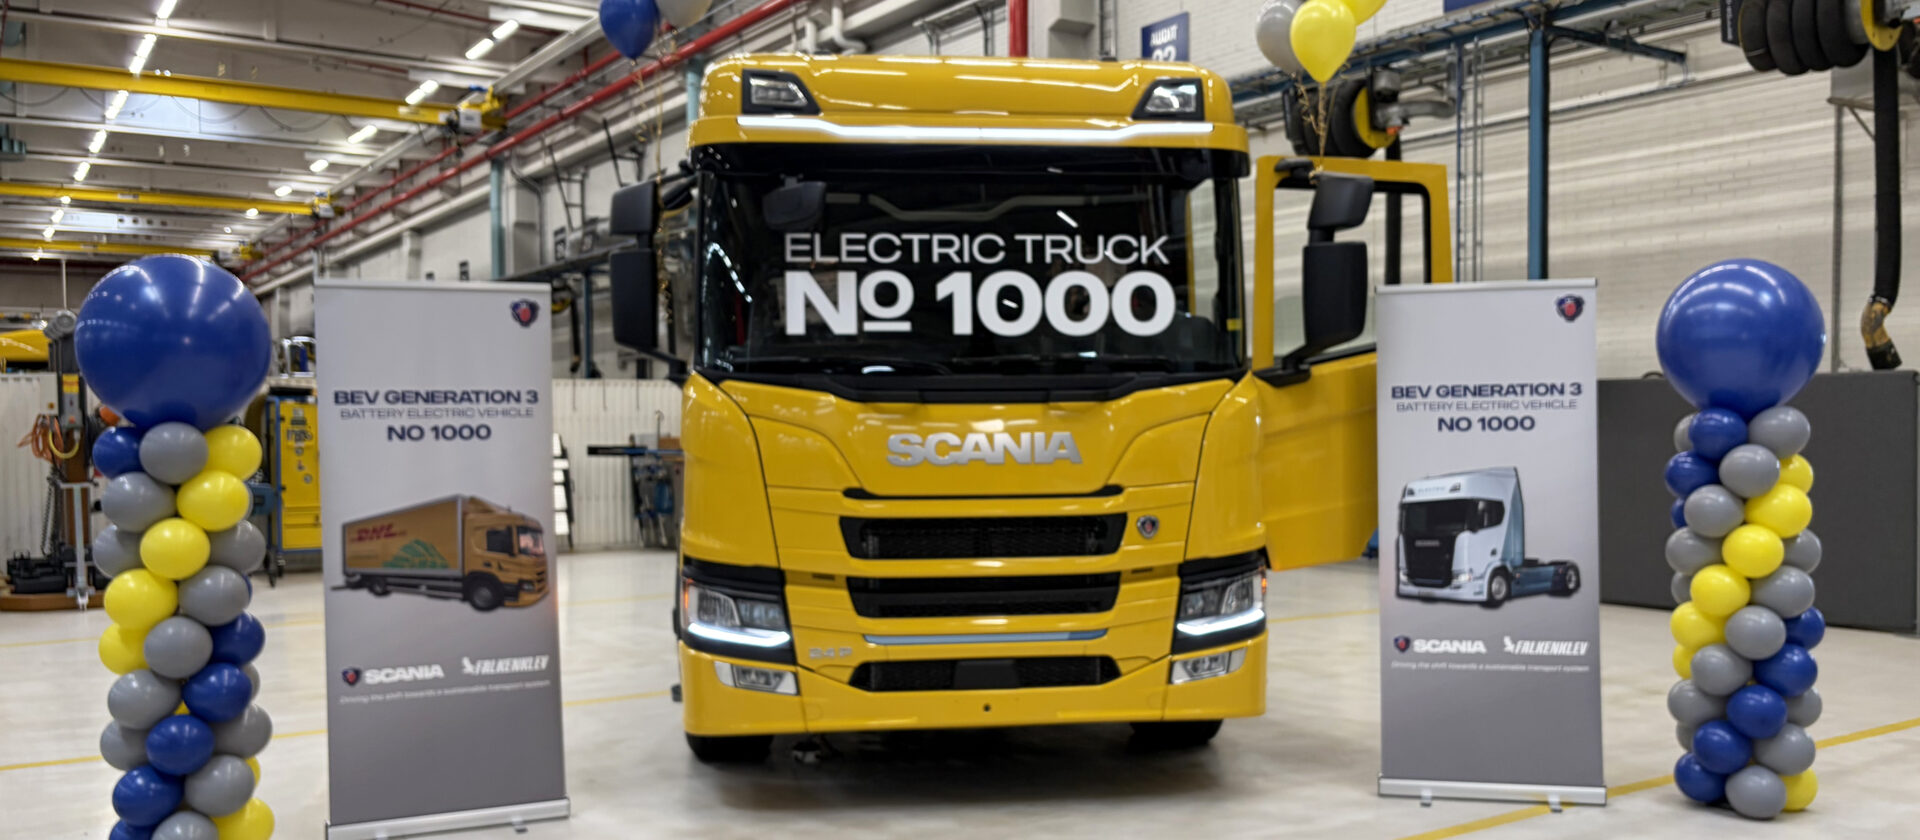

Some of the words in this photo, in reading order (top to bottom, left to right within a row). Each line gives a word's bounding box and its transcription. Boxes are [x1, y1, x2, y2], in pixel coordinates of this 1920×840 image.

[785, 233, 1006, 264] ELECTRIC
[1014, 234, 1170, 265] TRUCK
[936, 270, 1176, 337] 1000
[334, 390, 380, 405] BEV
[385, 390, 521, 405] GENERATION
[525, 390, 539, 404] 3
[1391, 385, 1432, 399] BEV
[1436, 382, 1566, 398] GENERATION
[1569, 382, 1582, 396] 3
[340, 407, 403, 420] BATTERY
[407, 407, 475, 419] ELECTRIC
[477, 406, 534, 418] VEHICLE
[1396, 401, 1454, 412] BATTERY
[1456, 400, 1520, 412] ELECTRIC
[1521, 399, 1577, 410] VEHICLE
[1437, 417, 1472, 432] NO
[1477, 416, 1536, 431] 1000
[387, 424, 425, 441] NO
[430, 424, 492, 441] 1000
[886, 431, 1084, 467] SCANIA
[1413, 639, 1487, 653] SCANIA
[1514, 640, 1588, 656] FALKENKLEV
[364, 664, 445, 685] SCANIA
